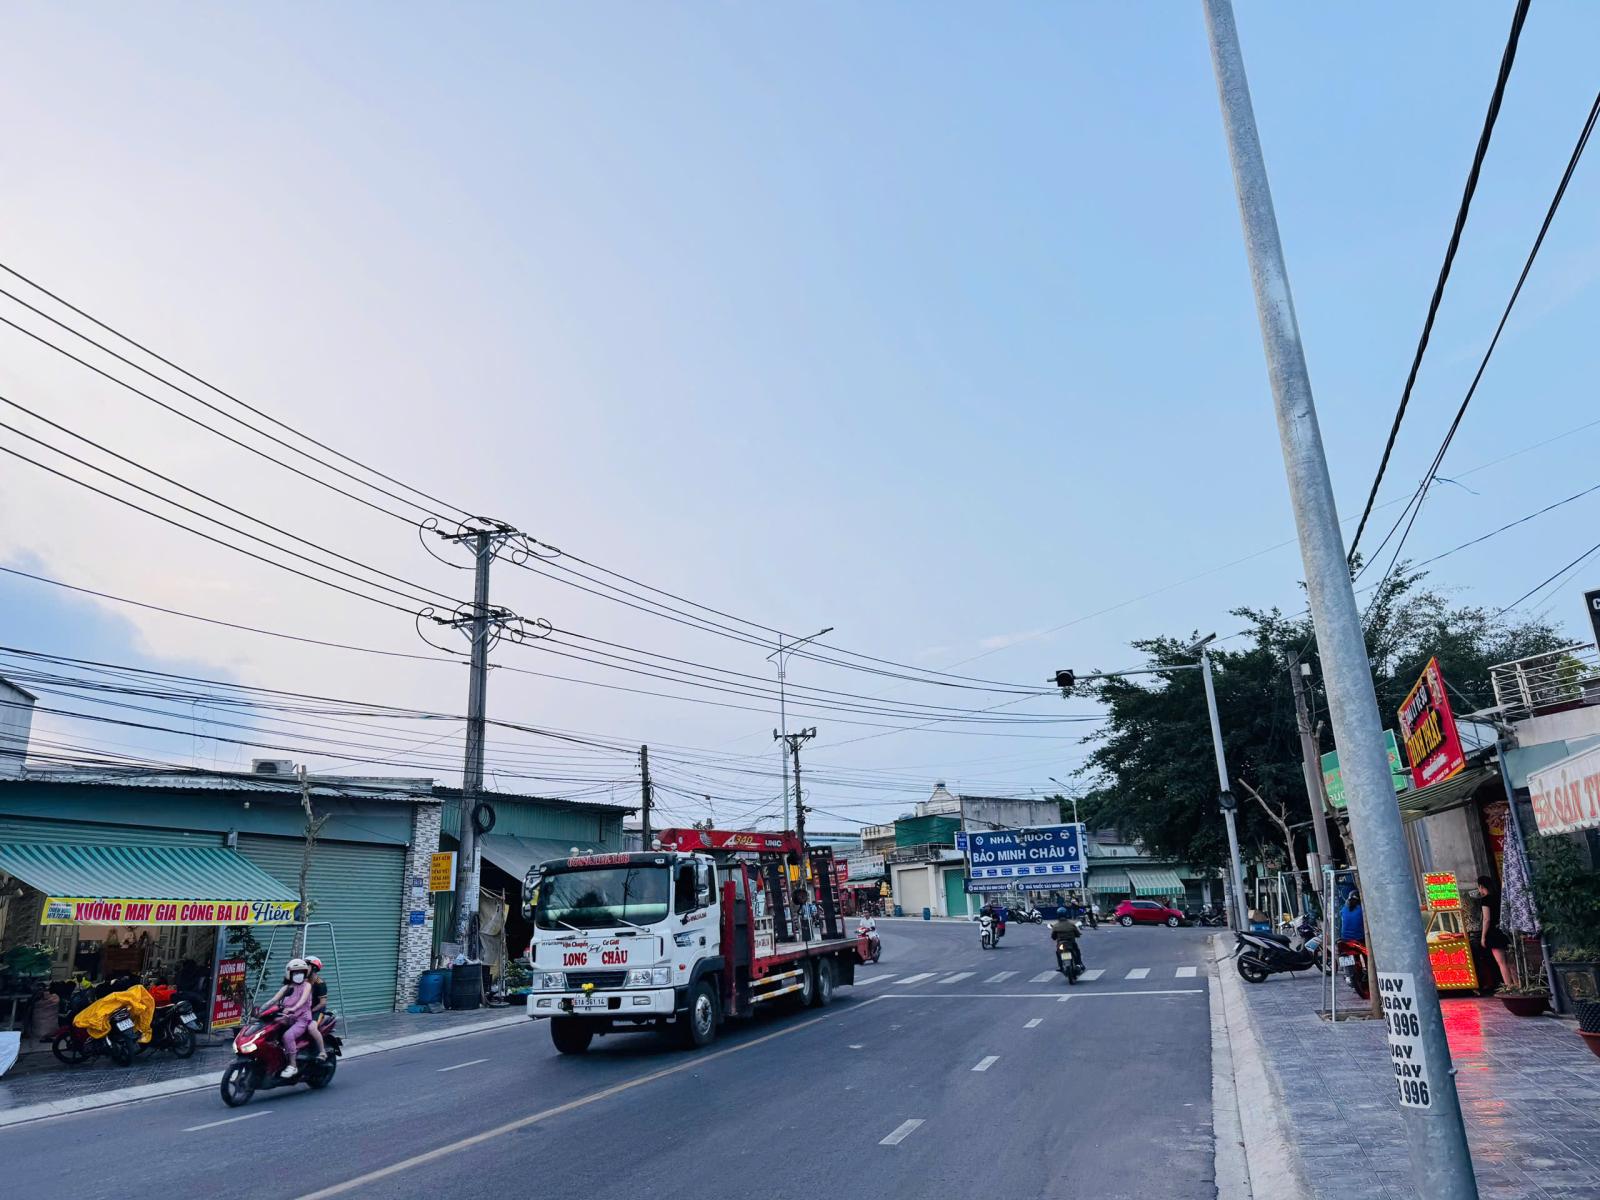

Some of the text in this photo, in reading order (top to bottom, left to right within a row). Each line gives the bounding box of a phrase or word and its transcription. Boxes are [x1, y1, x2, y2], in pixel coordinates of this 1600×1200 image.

[989, 833, 1013, 845] NHÀ
[972, 844, 1077, 863] BẢO MINH CHÂU 9
[75, 898, 122, 920] XƯỞNG
[125, 903, 154, 920] MAY
[155, 904, 177, 920] GIA
[181, 901, 215, 920] CÔNG
[217, 904, 233, 920] BA
[563, 953, 587, 966] LONG
[602, 946, 628, 965] CHÂU
[1393, 1013, 1419, 1036] 996
[1393, 1061, 1421, 1078] GÀY
[1403, 1080, 1429, 1105] 996
